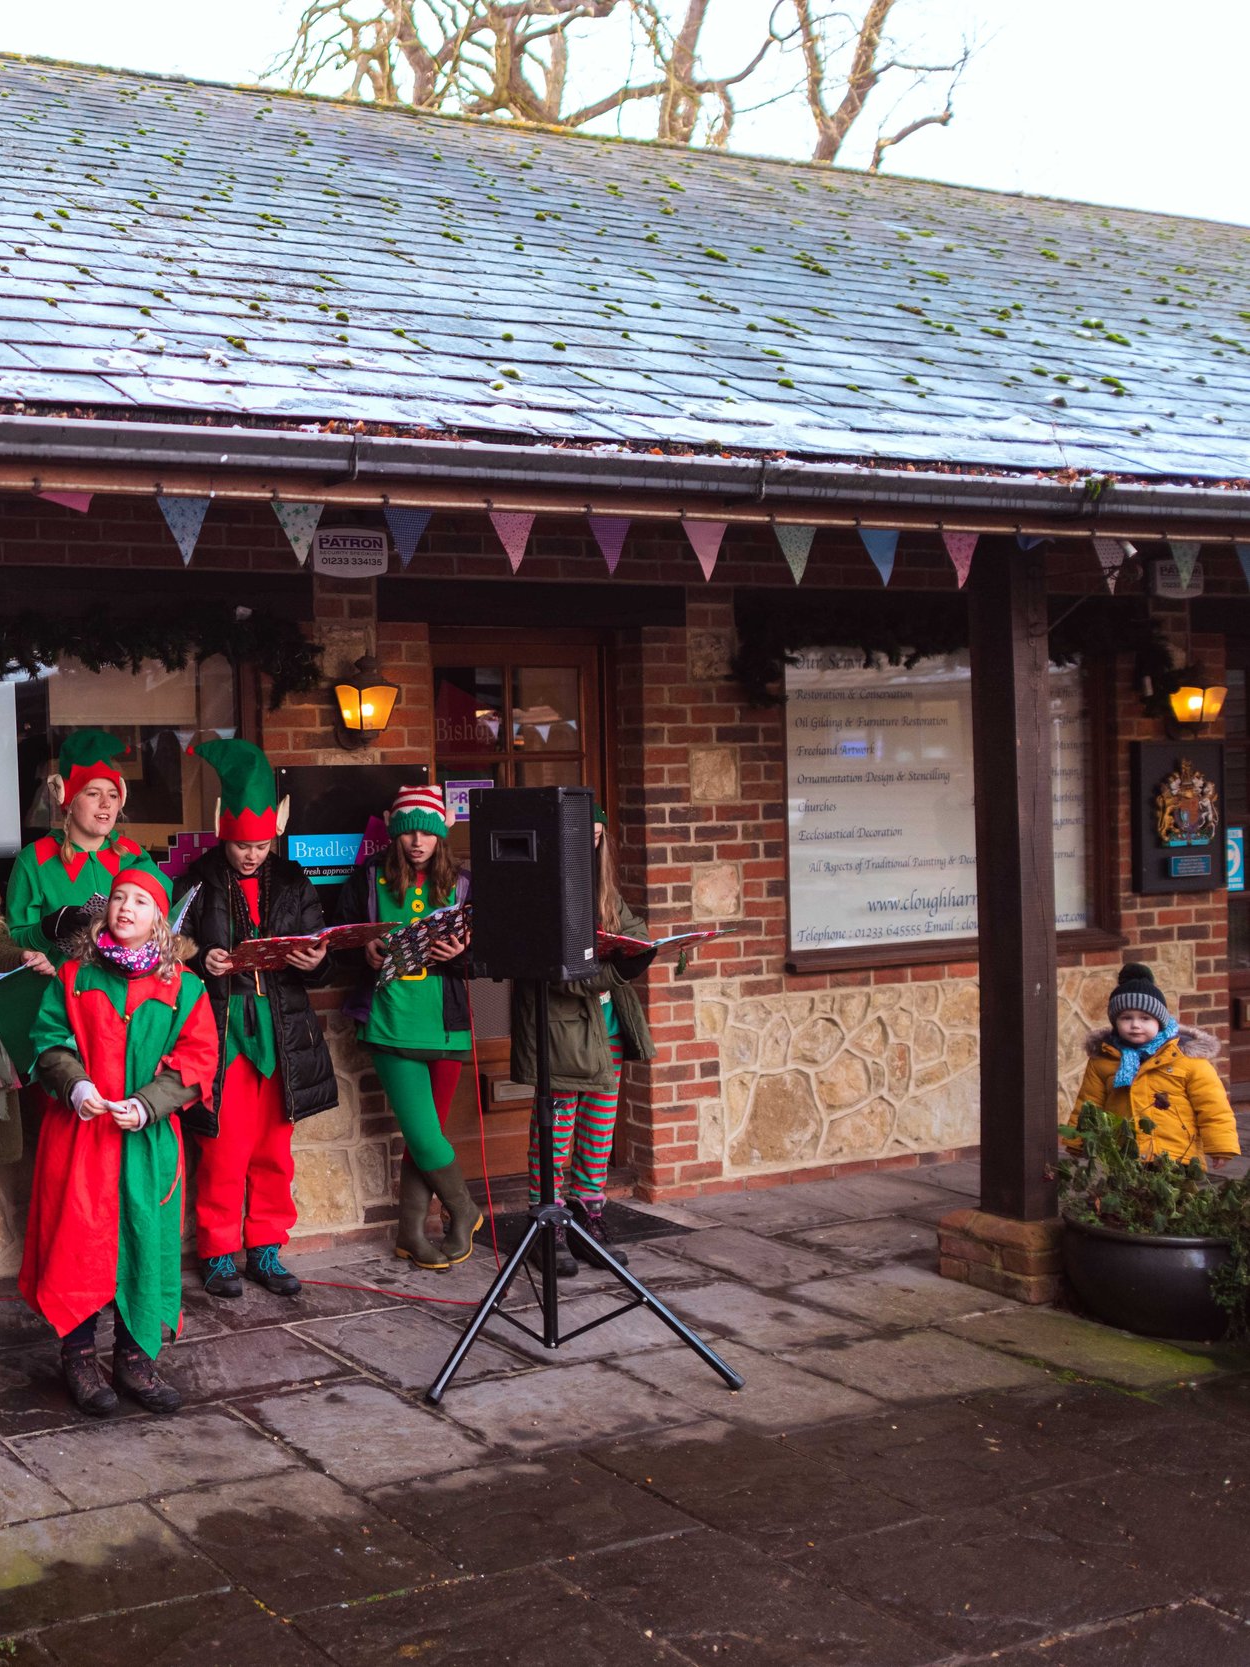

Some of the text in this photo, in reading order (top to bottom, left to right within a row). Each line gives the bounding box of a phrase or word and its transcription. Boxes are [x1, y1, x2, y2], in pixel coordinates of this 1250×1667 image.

[319, 537, 383, 549] PATRON
[322, 557, 382, 566] 01233 334135
[795, 688, 913, 700] Restoration & Conservation
[435, 716, 496, 744] Bishop
[795, 714, 948, 731] Oil Gilding & Furniture Restoration
[797, 742, 876, 756] Freehand Artwork
[797, 767, 950, 786] Ornamentation Design & Stencilling
[449, 791, 469, 804] PR
[798, 799, 837, 813] Churches
[798, 825, 902, 841] Ecclesiastical Decoration
[295, 840, 358, 859] Bradley
[303, 865, 355, 877] fresh approach
[809, 859, 822, 873] All
[824, 860, 853, 876] Aspects
[855, 859, 863, 875] of
[865, 855, 910, 870] Traditional
[913, 855, 946, 871] Painting
[948, 856, 956, 866] &
[797, 925, 846, 947] Telephone
[855, 927, 883, 939] 01233
[886, 923, 921, 937] 645555
[924, 915, 955, 933] Email
